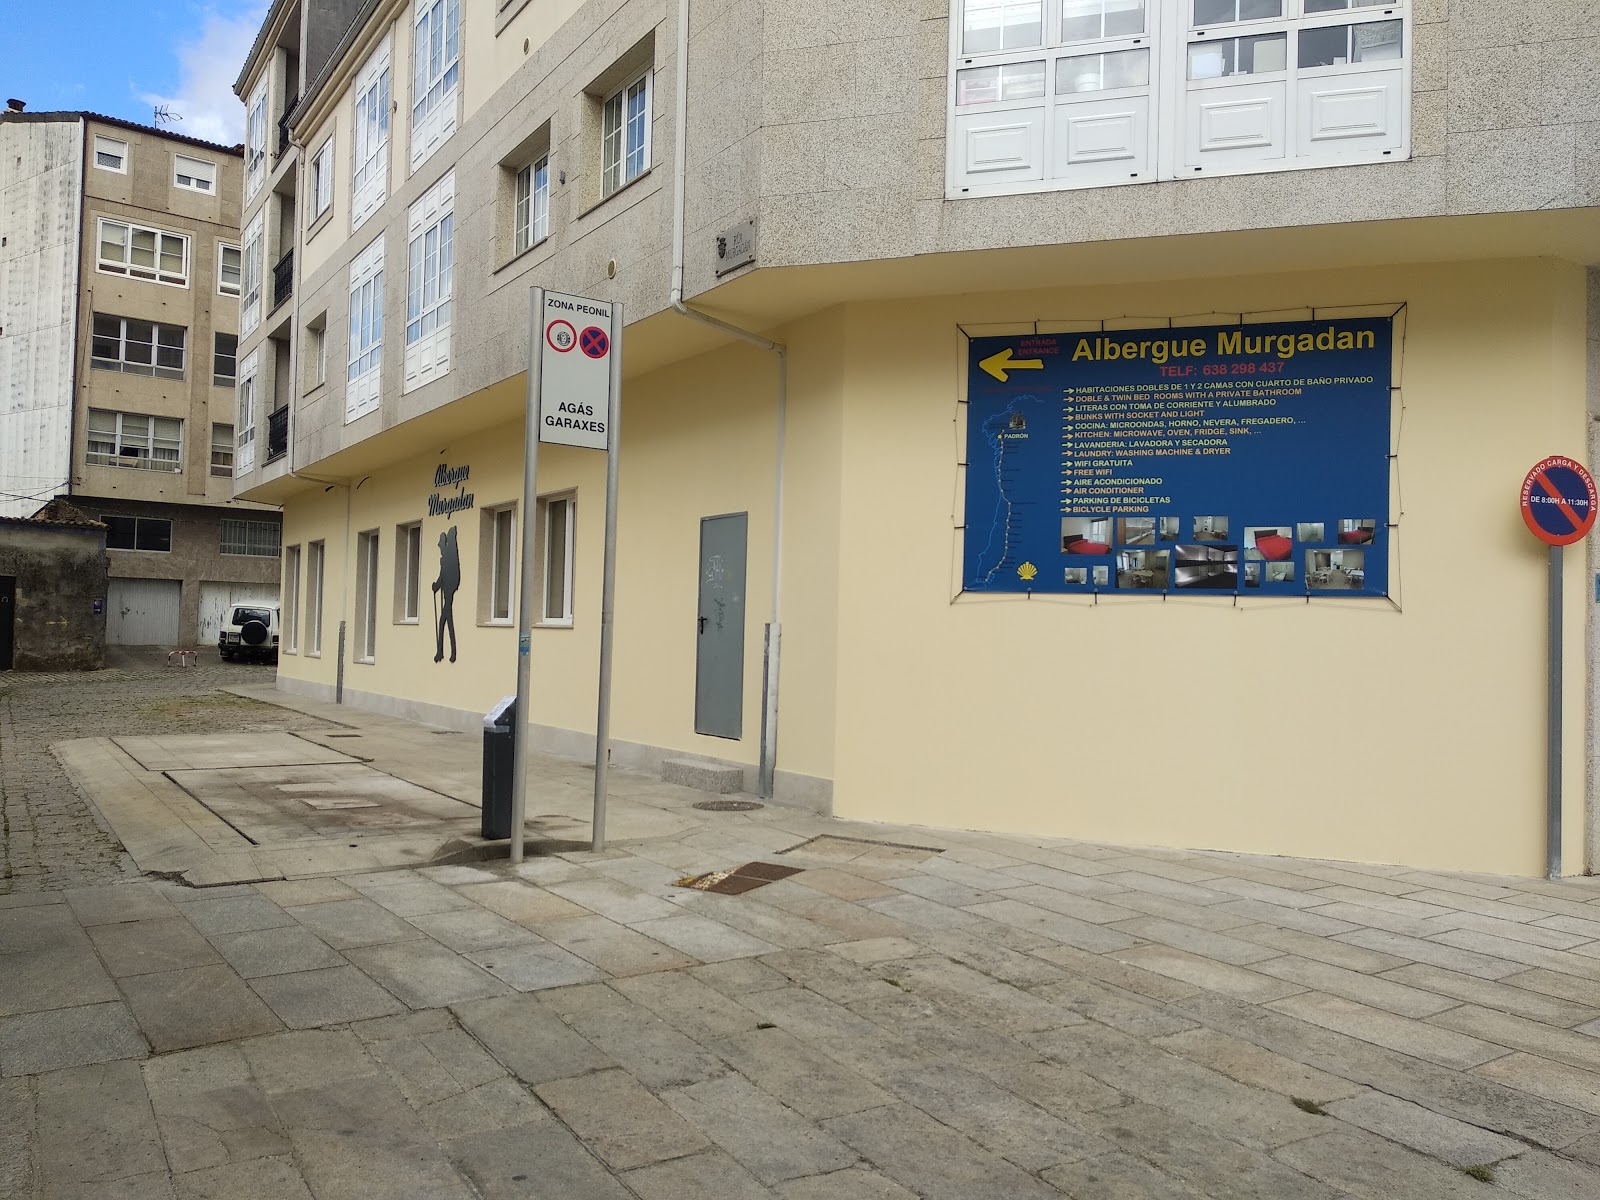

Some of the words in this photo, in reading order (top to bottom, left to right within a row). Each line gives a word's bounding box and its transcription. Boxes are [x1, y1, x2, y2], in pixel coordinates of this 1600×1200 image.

[548, 298, 574, 311] ZONA
[576, 304, 610, 318] PEONIL
[1020, 338, 1057, 347] ENTRADA
[1072, 337, 1207, 364] Albergue
[1217, 326, 1375, 359] Murgadan
[1018, 347, 1060, 356] ENTRANCE
[1160, 366, 1197, 377] TELF:
[1202, 364, 1228, 376] 638
[1231, 362, 1256, 375] 298
[1259, 362, 1285, 374] 437
[1076, 385, 1135, 394] HABITACIONES
[1136, 384, 1169, 392] DOBLES
[1256, 380, 1292, 388] CUARTO
[1307, 376, 1332, 385] BAÑO
[1334, 376, 1374, 384] PRIVADO
[1154, 392, 1184, 400] ROOMS
[1215, 390, 1251, 398] PRIVATE
[1253, 388, 1302, 396] BATHROOM
[558, 401, 594, 416] AGÁS
[1076, 404, 1108, 412] LITERAS
[1110, 403, 1127, 411] CON
[1129, 402, 1152, 410] TOMA
[1166, 401, 1214, 409] CORRIENTE
[1222, 399, 1277, 407] ALUMBRADO
[1075, 413, 1103, 421] BUNKS
[1075, 422, 1108, 430] COCINA:
[1110, 421, 1166, 429] MICROONDAS,
[1168, 420, 1201, 428] HORNO,
[1241, 417, 1296, 425] FREGADERO,
[545, 415, 605, 433] GARAXES
[1074, 431, 1112, 439] KITCHEN:
[1194, 428, 1228, 436] FRIDGE,
[1229, 427, 1252, 435] SINK,
[1074, 441, 1128, 449] LAVANDERIA:
[1074, 450, 1114, 458] LAUNDRY:
[1115, 449, 1154, 457] WASHING
[1155, 448, 1193, 456] MACHINE
[1092, 459, 1133, 467] GRATUITA
[435, 464, 469, 489] Albergue
[1073, 478, 1092, 486] AIRE
[1522, 464, 1546, 506] RESERVADO
[1546, 459, 1572, 468] CARGA
[1578, 469, 1596, 512] DESCARGA
[428, 486, 474, 520] Murgadan
[1530, 495, 1540, 503] DE
[1541, 496, 1560, 504] 8:00H
[1561, 497, 1567, 505] A
[1568, 498, 1589, 506] 11:30H
